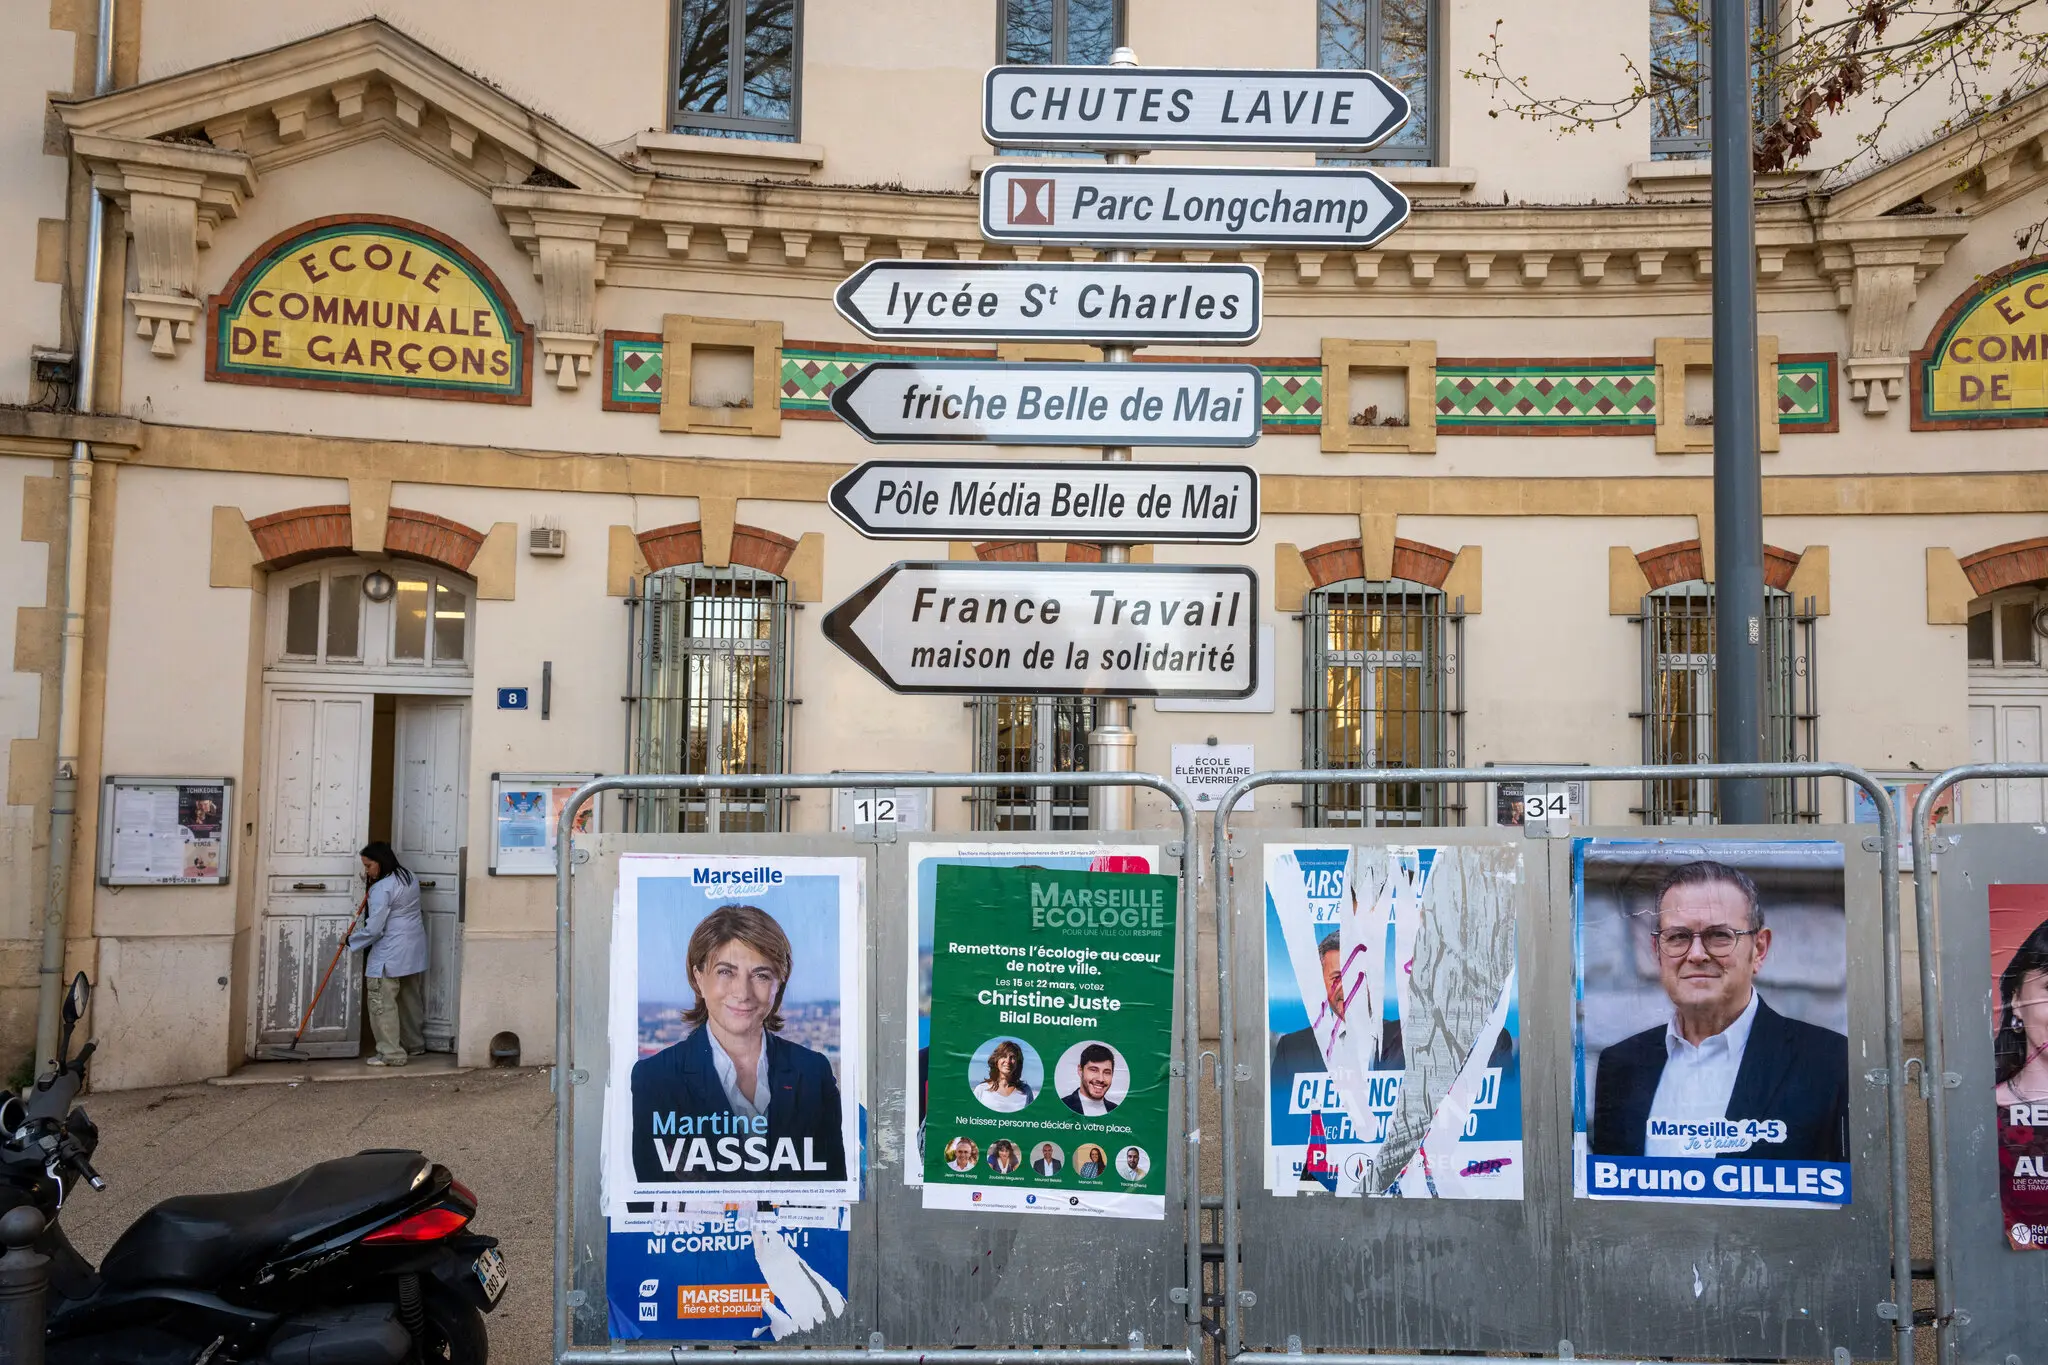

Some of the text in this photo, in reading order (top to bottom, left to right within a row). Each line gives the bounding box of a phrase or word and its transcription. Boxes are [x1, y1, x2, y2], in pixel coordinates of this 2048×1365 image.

[1009, 86, 1355, 125] CHUTES LAVIE
[1072, 185, 1369, 232] Parc Longchamp
[298, 244, 450, 294] ECOLE
[248, 290, 493, 337] COMMUNALE
[887, 281, 1240, 324] lycée St Charles
[232, 326, 510, 377] DE GARÇONS
[1960, 375, 2011, 402] DE
[902, 383, 1245, 423] friche Belle de Mai
[874, 480, 1239, 520] Pôle Média Belle de Mai
[912, 587, 1240, 627] France Travail
[911, 640, 1235, 673] maison de la solidarité
[508, 693, 517, 704] 8
[1175, 765, 1250, 775] ÉLÉMENTAIRE
[1195, 756, 1230, 766] ÉCOLE
[1186, 776, 1240, 784] LEVERRIER
[858, 800, 869, 822] 1
[877, 800, 894, 821] 2
[1526, 798, 1545, 817] 3
[1548, 795, 1567, 815] 4
[693, 867, 783, 885] Marseille
[708, 884, 764, 896] Je t'aime
[1031, 882, 1163, 908] MARSEILLE
[1032, 907, 1163, 929] ECOLOG!E
[1118, 929, 1132, 937] QUI
[1133, 929, 1162, 937] RESPIRE
[949, 942, 1160, 964] Remettons l'écologie au cœur
[1006, 959, 1102, 976] de notre ville.
[995, 977, 1105, 991] Les 15 et 22 mars, votez
[977, 989, 1121, 1011] Christine Juste
[1000, 1012, 1097, 1028] Bilal Boualem
[652, 1111, 768, 1135] Martine
[956, 1116, 1132, 1134] Ne laissez personne décider à votre place.
[1651, 1120, 1738, 1138] Marseille
[653, 1137, 828, 1172] VASSAL
[1683, 1137, 1701, 1151] Je
[1594, 1162, 1845, 1197] Bruno GILLES
[647, 1239, 665, 1254] NI
[642, 1284, 656, 1292] REV
[682, 1288, 770, 1303] MARSEILLE
[641, 1304, 657, 1317] VAÏ
[684, 1303, 706, 1313] fière
[709, 1304, 720, 1312] et
